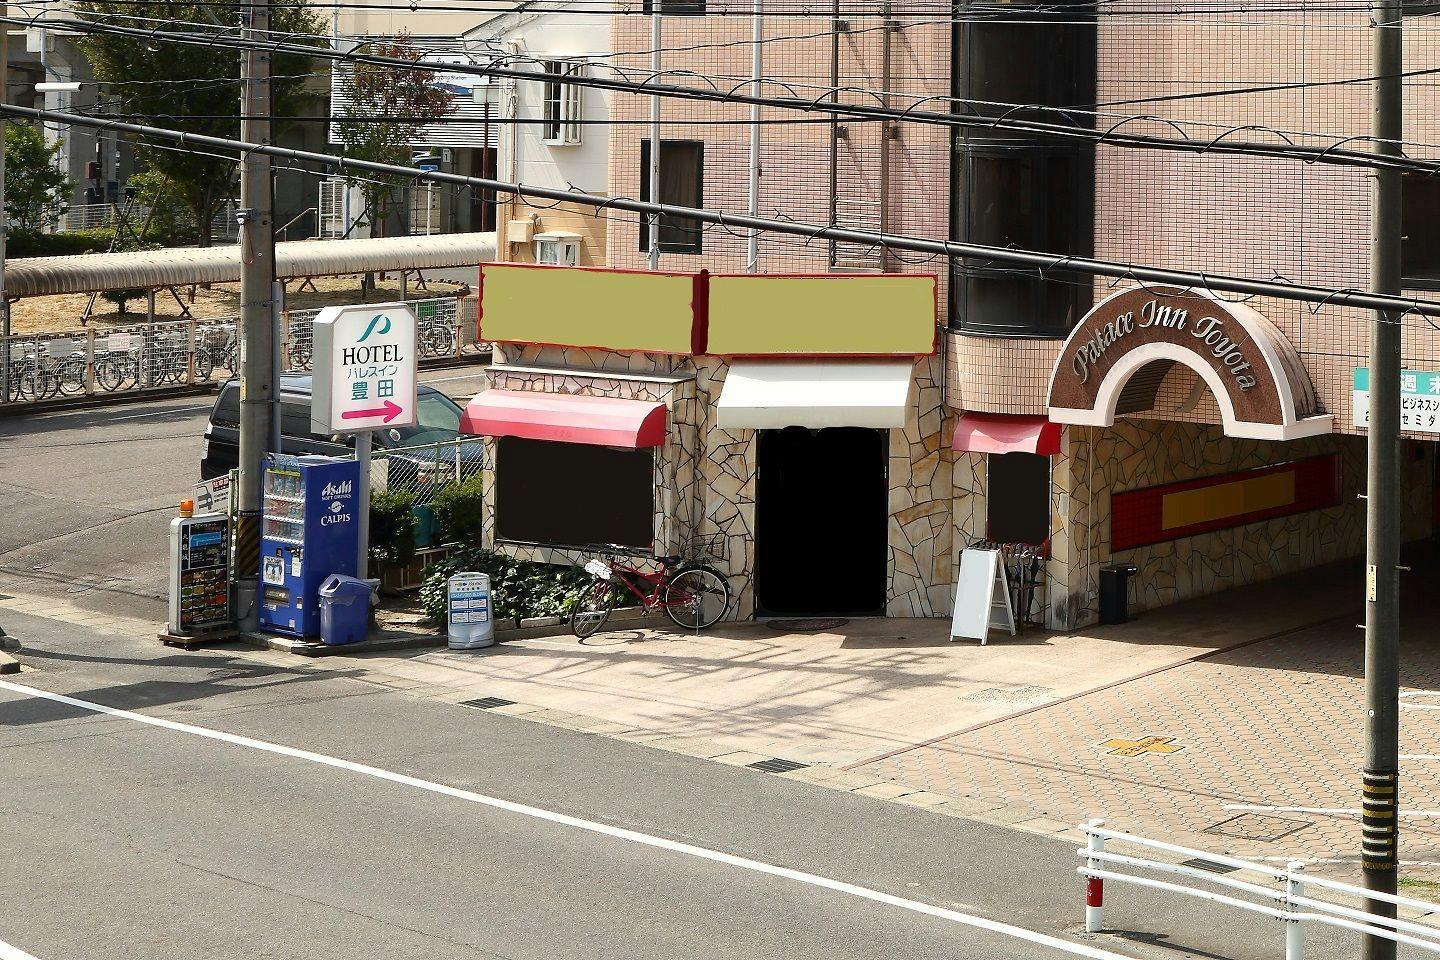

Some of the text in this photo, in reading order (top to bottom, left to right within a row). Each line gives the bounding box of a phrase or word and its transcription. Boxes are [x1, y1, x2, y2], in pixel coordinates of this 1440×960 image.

[1072, 298, 1257, 392] Palace Inn Toyota
[342, 344, 404, 366] HOTEL
[347, 365, 399, 379] パレスイン
[351, 379, 394, 401] 豊田
[321, 480, 352, 496] Asahi
[320, 513, 351, 526] CALPIS
